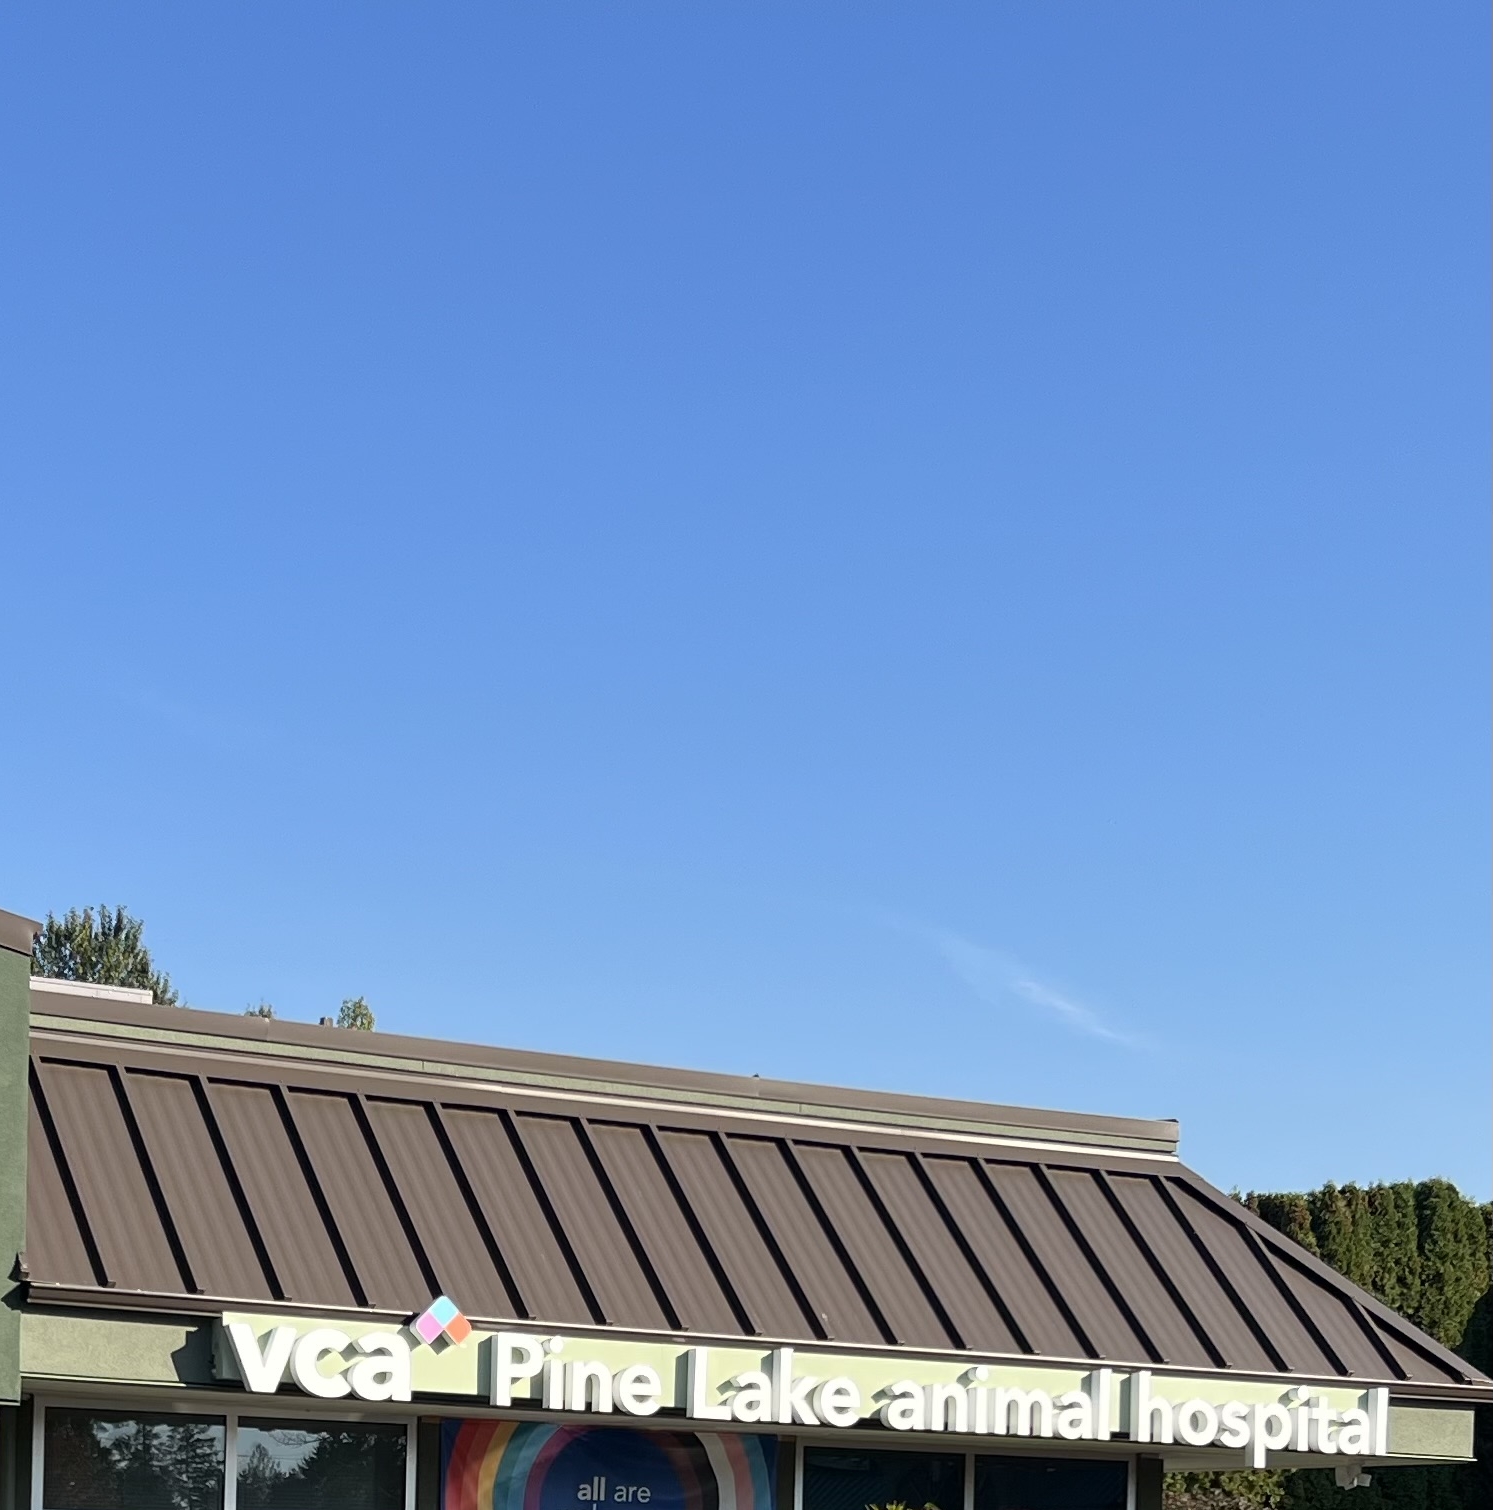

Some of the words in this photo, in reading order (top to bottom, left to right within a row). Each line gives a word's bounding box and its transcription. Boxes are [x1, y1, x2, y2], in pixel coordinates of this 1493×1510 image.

[225, 1322, 412, 1402] vca
[489, 1331, 663, 1416] Pine
[687, 1347, 861, 1428] Lake
[880, 1365, 1113, 1441] animal
[1131, 1369, 1390, 1469] hospital
[577, 1476, 606, 1502] all
[613, 1485, 652, 1504] are
